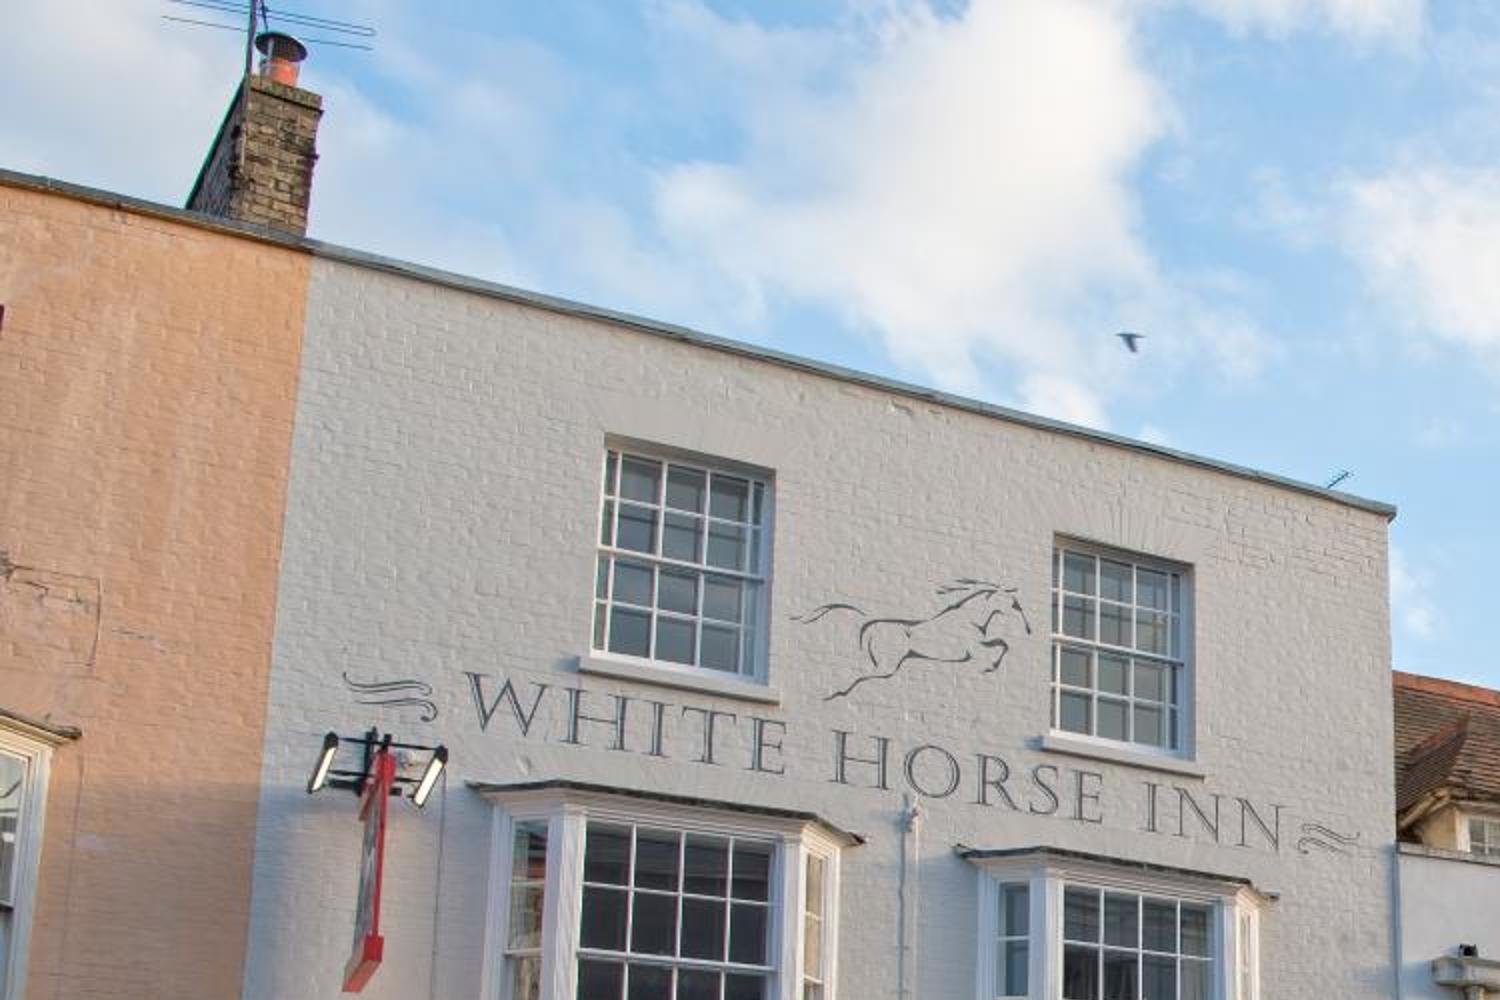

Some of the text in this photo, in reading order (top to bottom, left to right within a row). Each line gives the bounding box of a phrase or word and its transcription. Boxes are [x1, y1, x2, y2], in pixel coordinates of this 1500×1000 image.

[465, 671, 1288, 851] WHITE HORSE INN
